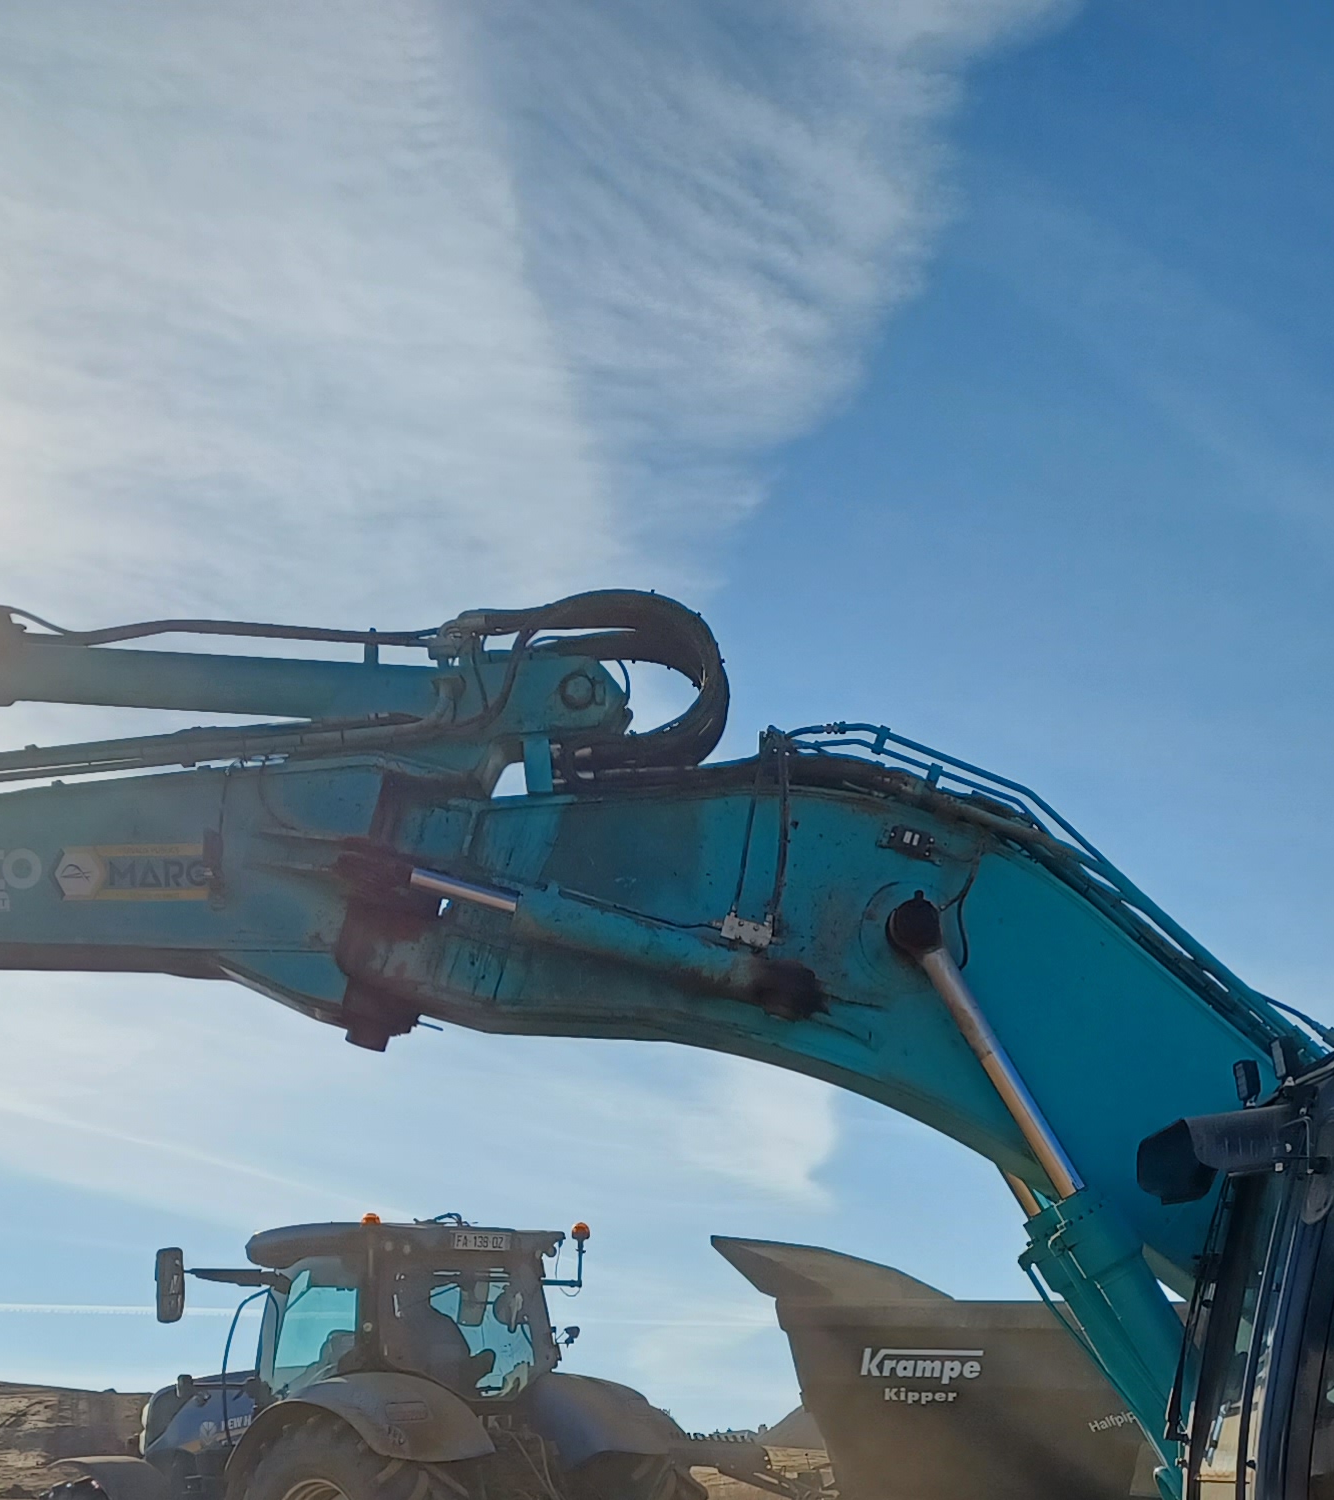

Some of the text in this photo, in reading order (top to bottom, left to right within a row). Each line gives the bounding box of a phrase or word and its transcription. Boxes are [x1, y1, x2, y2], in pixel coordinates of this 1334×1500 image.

[860, 1347, 984, 1385] Krampe
[884, 1387, 957, 1404] Kipper
[1088, 1411, 1135, 1433] Halfpip
